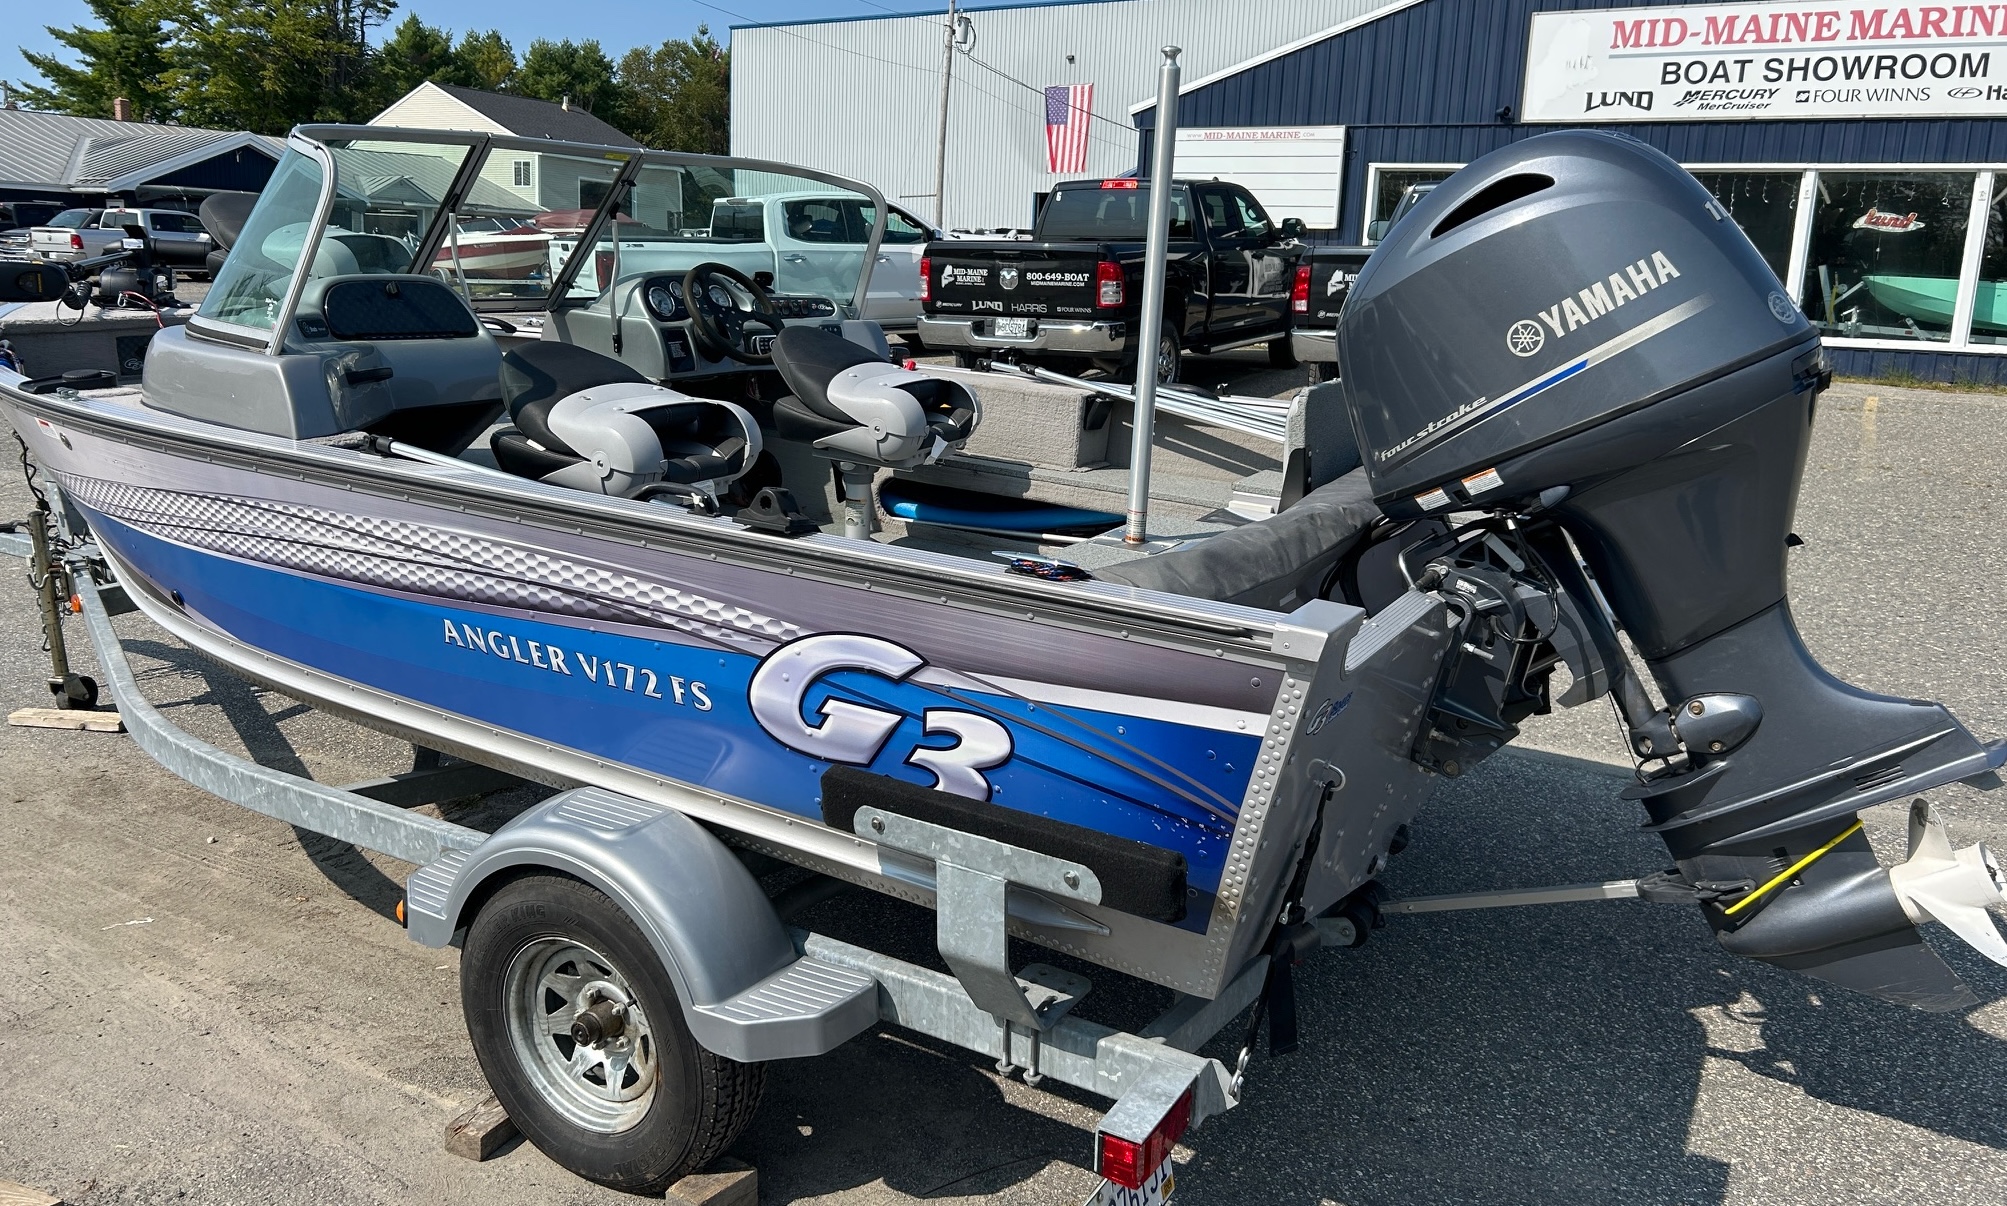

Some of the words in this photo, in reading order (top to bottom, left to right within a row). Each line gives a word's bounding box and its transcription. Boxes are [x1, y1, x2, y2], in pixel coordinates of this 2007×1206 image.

[1610, 11, 1841, 49] MID-MAINE
[1660, 59, 1753, 86] BOAT
[1762, 52, 1991, 83] SHOWROOM
[1584, 91, 1654, 113] LUND
[1674, 88, 1781, 105] MERCURY
[1813, 89, 1862, 103] FOUR
[1866, 87, 1931, 102] WINNS
[1697, 101, 1772, 111] MerCruiser
[1203, 131, 1258, 140] MID-MAINE
[1260, 131, 1301, 139] MARINE
[953, 268, 988, 276] MID-MAINE
[956, 275, 981, 283] MARINE
[1026, 272, 1090, 282] 800-649-BOAT
[1538, 250, 1681, 339] YAMAHA
[972, 300, 1003, 312] LUND
[1011, 303, 1048, 313] HARRIS
[442, 618, 573, 676] ANGLER
[575, 651, 662, 699] V172
[669, 674, 713, 712] FS
[746, 630, 1015, 803] G3
